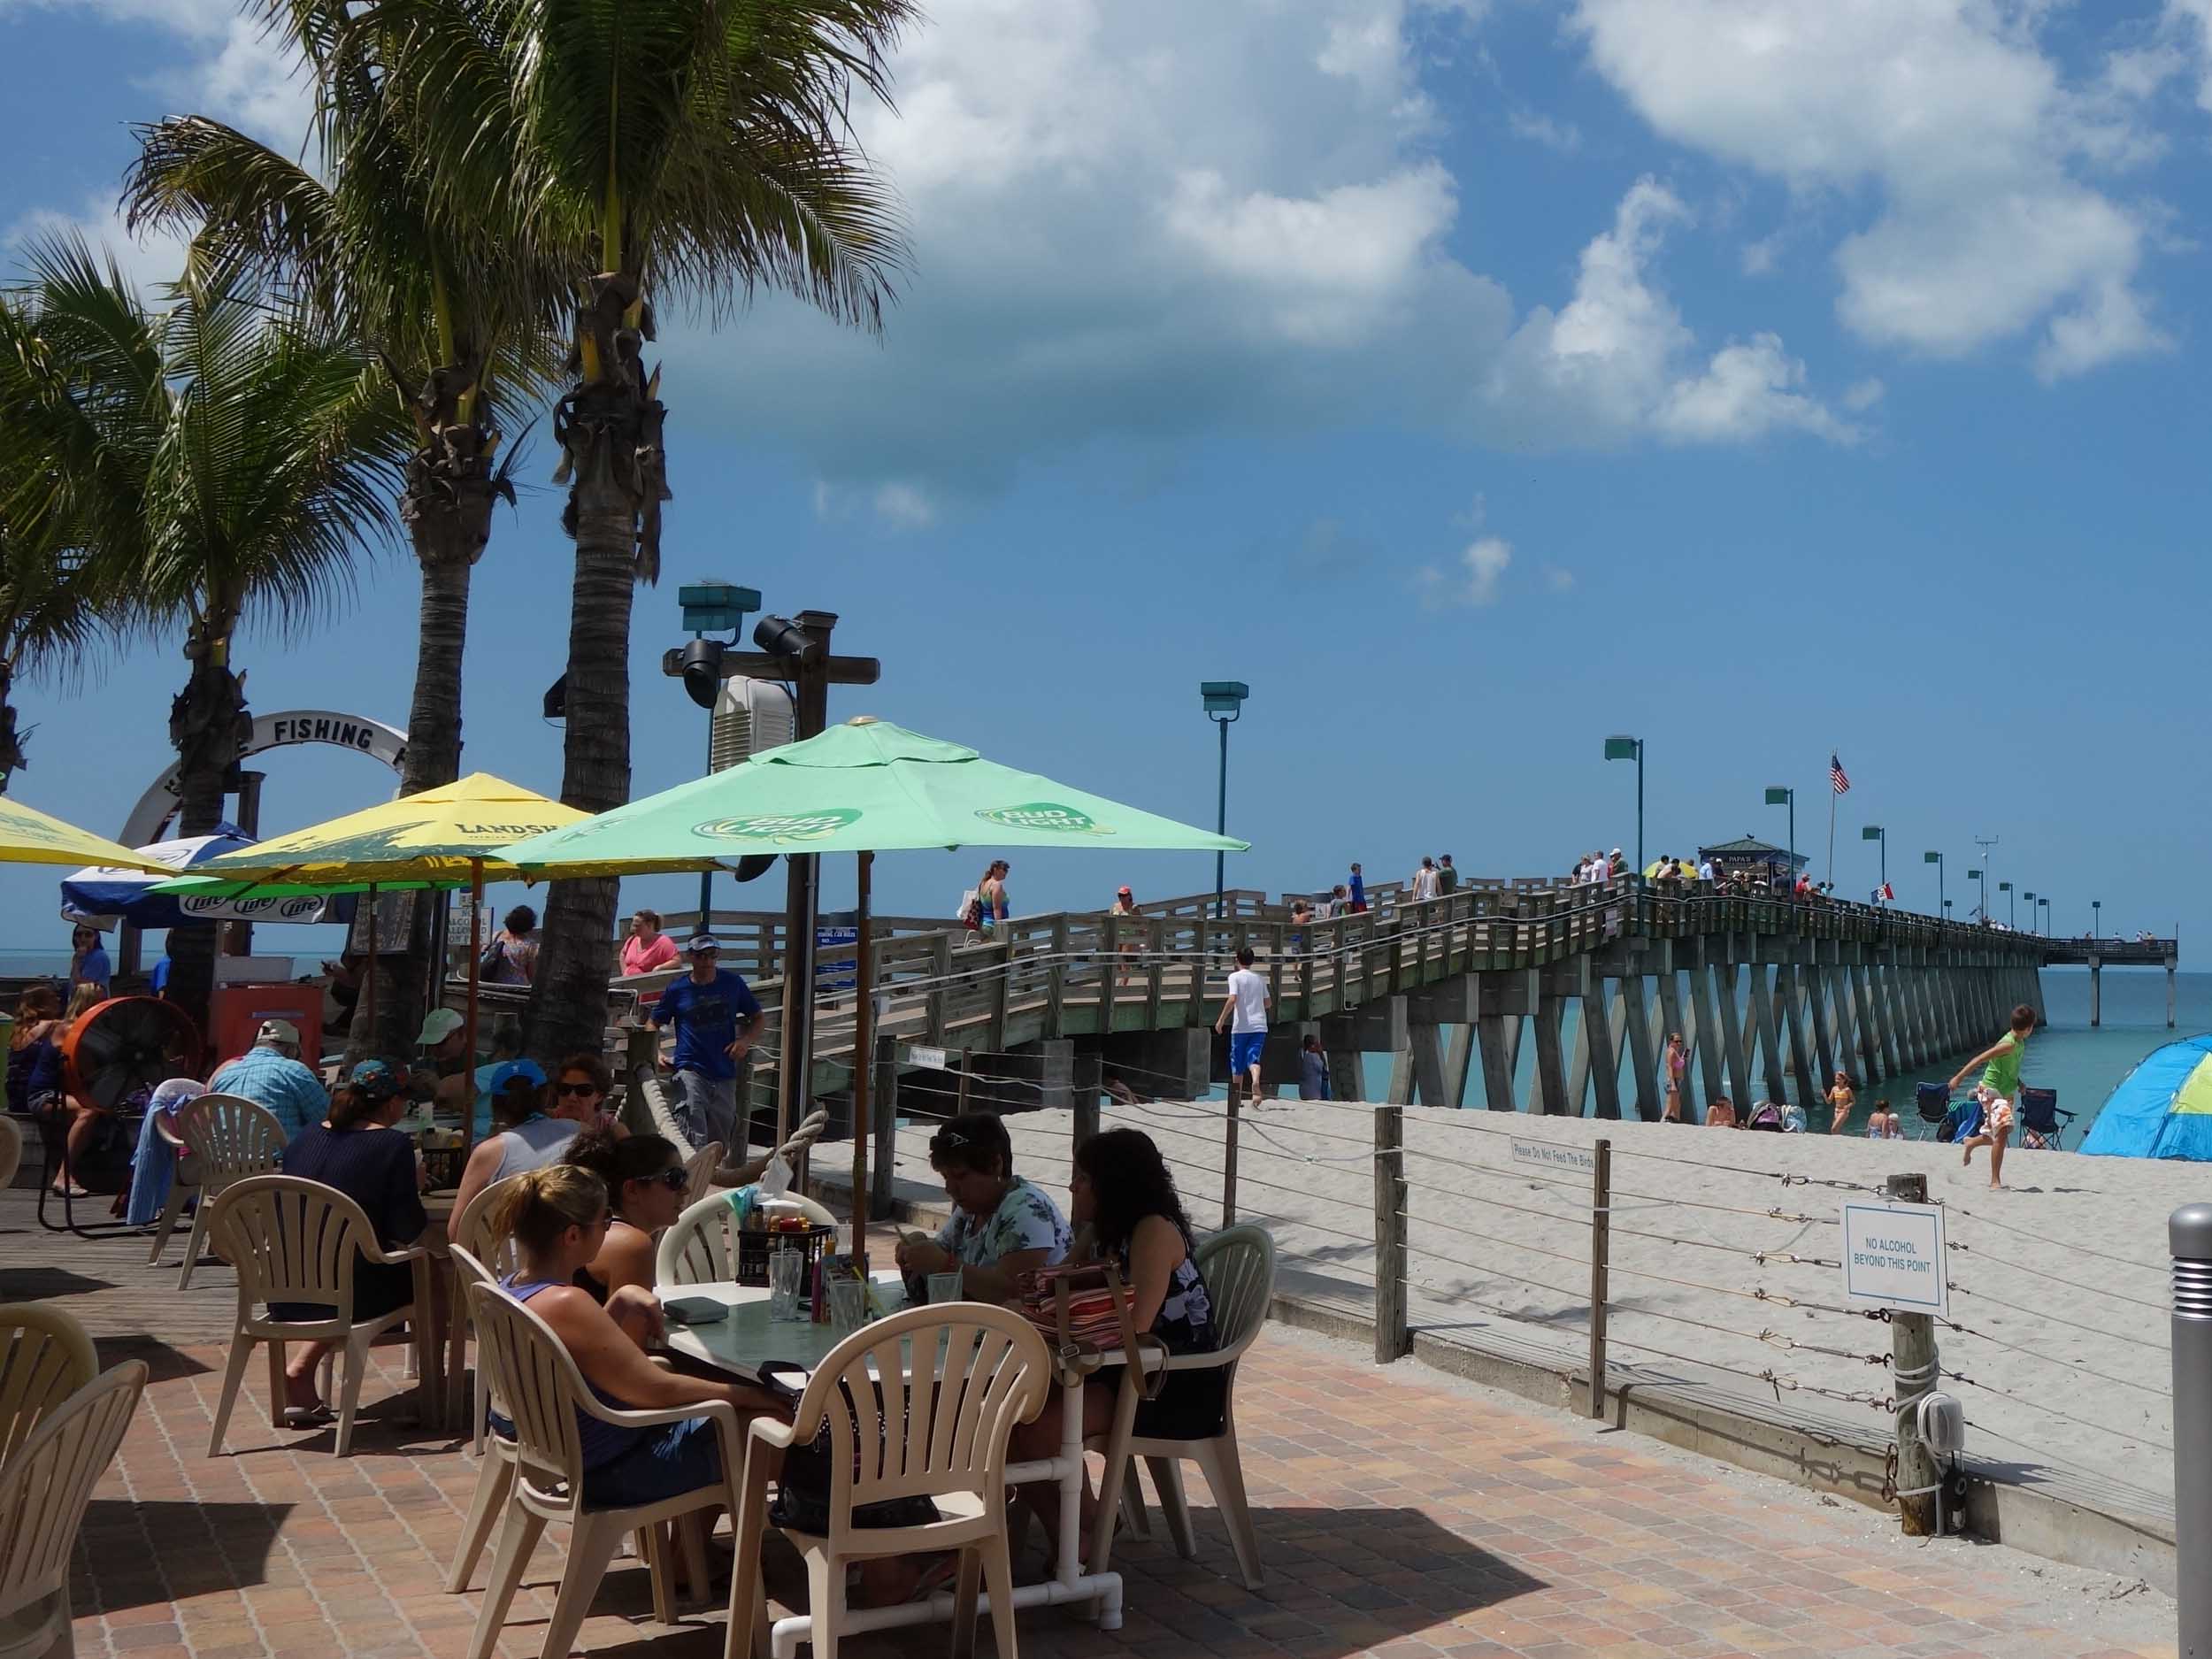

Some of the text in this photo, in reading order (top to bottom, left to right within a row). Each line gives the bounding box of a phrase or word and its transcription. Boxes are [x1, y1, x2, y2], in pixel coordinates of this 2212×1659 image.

[274, 718, 373, 749] FISHING
[1001, 810, 1067, 818] BUD
[1002, 816, 1086, 826] LIGHT
[193, 895, 221, 910] Lite
[242, 897, 270, 913] Lite
[288, 901, 318, 917] Lite
[1514, 1143, 1531, 1156] Please
[1532, 1146, 1540, 1159] Do
[1541, 1148, 1553, 1161] Not
[1553, 1149, 1566, 1164] Feed
[1566, 1152, 1578, 1165] The
[1866, 1237, 1917, 1255] NO ALCOHOL
[1855, 1253, 1931, 1274] BEYOND THIS POINT
